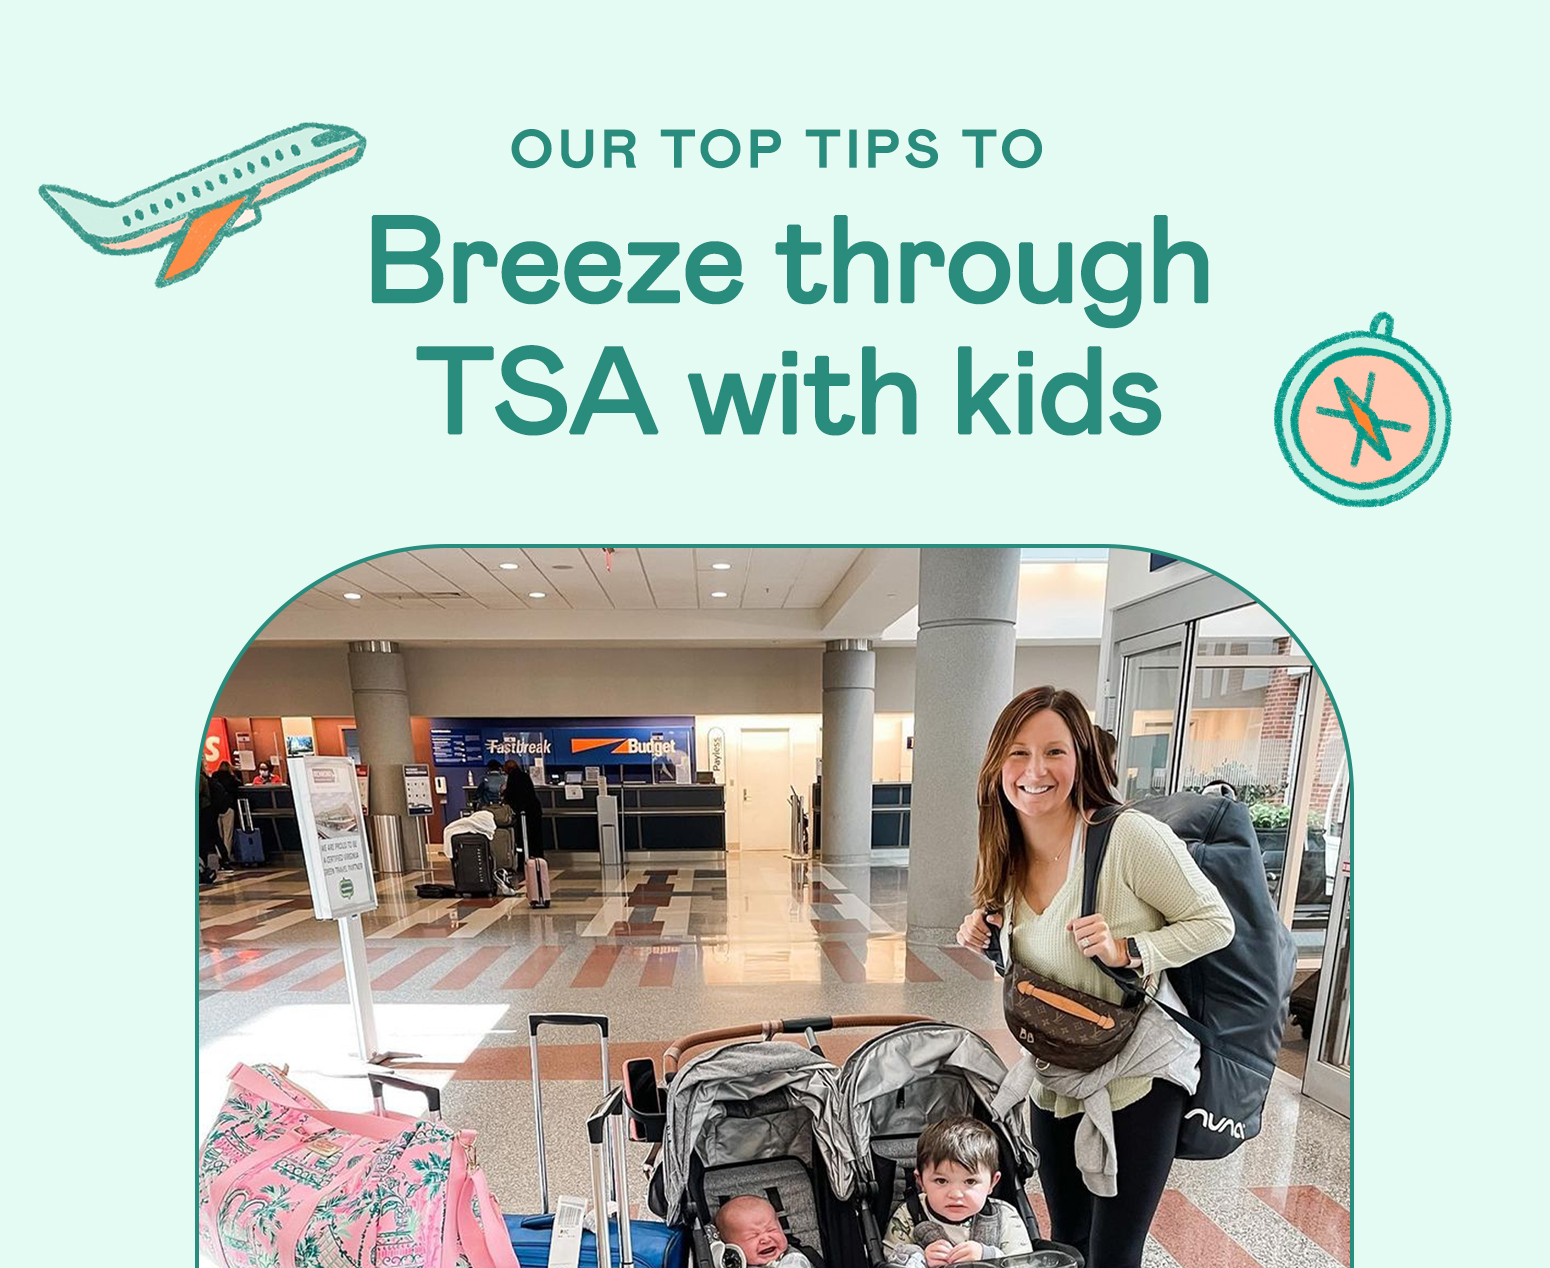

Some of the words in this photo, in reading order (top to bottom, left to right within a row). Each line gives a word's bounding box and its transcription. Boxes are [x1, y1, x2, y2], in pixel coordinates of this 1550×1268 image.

[485, 739, 551, 754] Fastbreak
[627, 738, 675, 757] Budget
[712, 736, 722, 771] Payless
[1184, 1108, 1244, 1140] nuna
